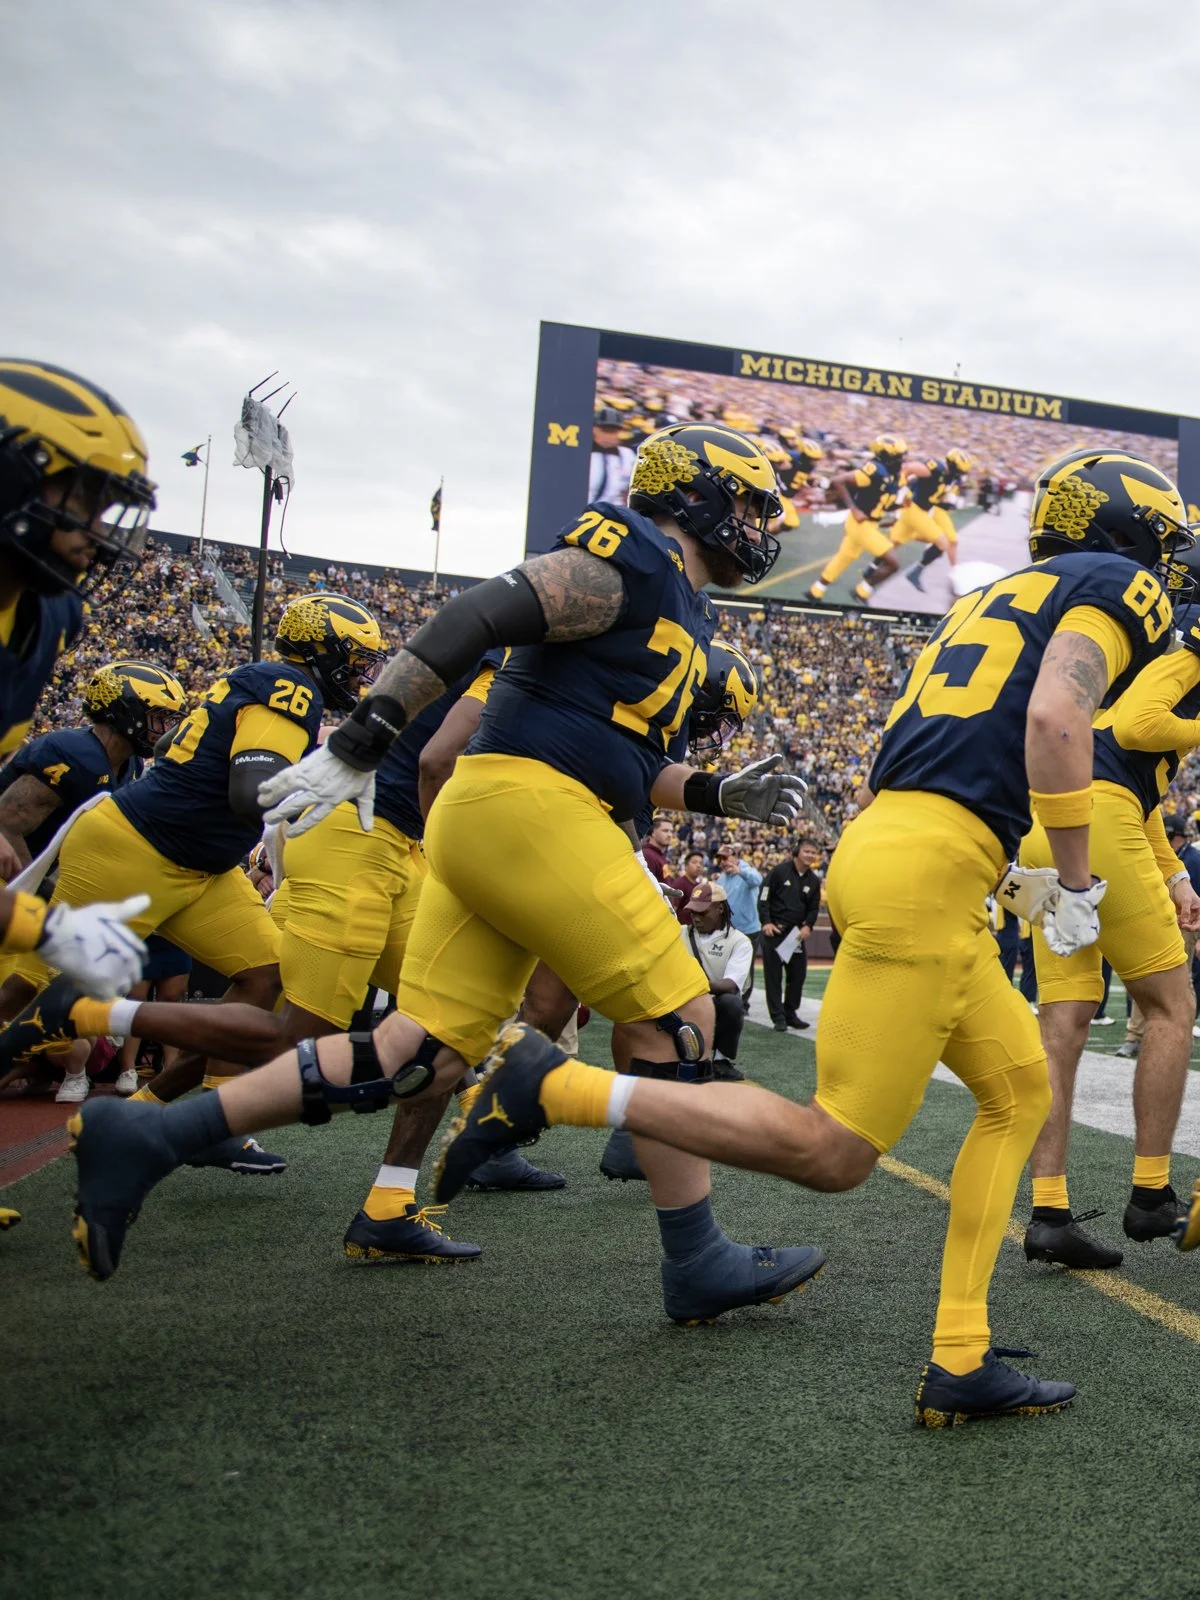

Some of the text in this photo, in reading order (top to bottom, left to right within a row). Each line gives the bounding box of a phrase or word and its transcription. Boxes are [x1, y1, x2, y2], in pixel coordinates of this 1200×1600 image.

[741, 354, 1062, 420] MICHIGAN STADIUM
[547, 422, 580, 447] M
[564, 511, 629, 558] 76
[268, 678, 314, 717] 26
[43, 763, 71, 785] 4
[1003, 880, 1021, 899] M
